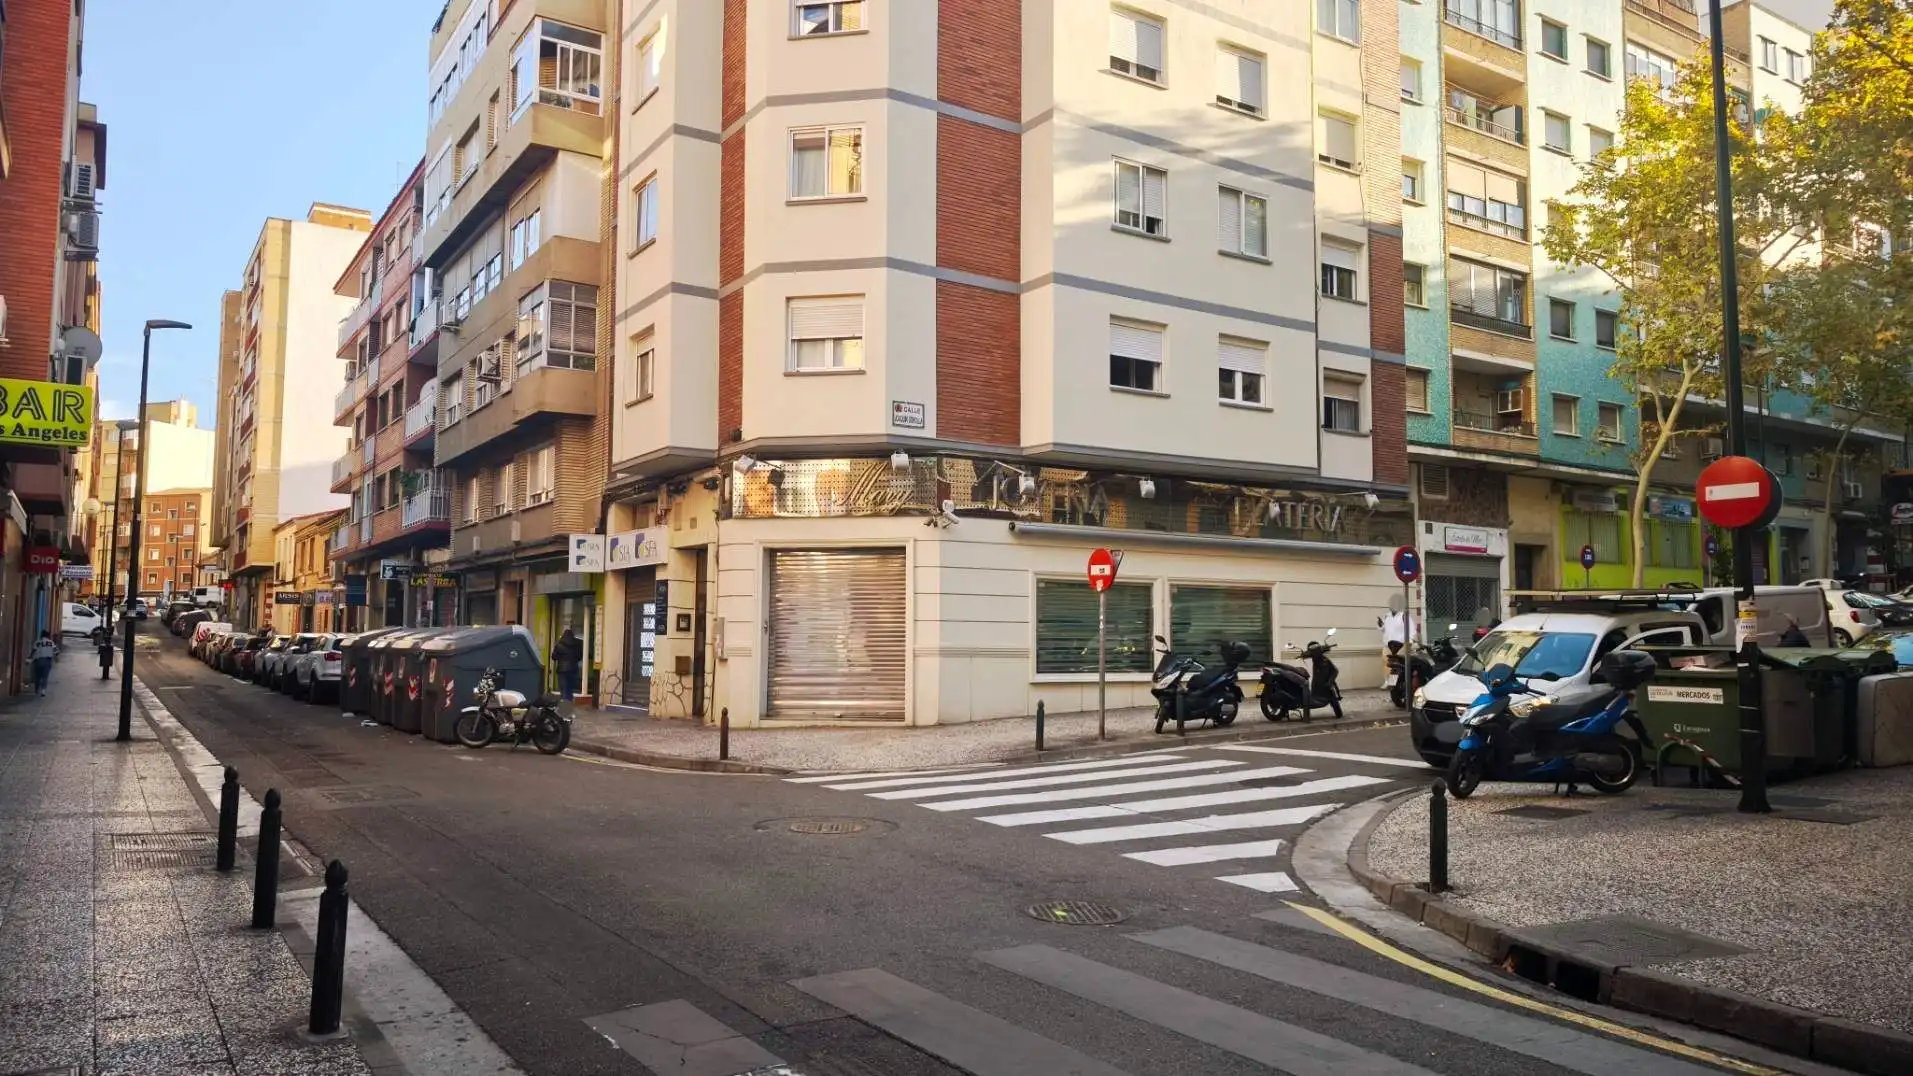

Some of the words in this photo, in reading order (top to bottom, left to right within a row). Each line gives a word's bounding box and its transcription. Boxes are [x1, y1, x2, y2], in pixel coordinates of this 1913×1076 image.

[0, 385, 85, 424] AR
[12, 423, 87, 441] Angeles
[1676, 690, 1711, 699] MERCADOS
